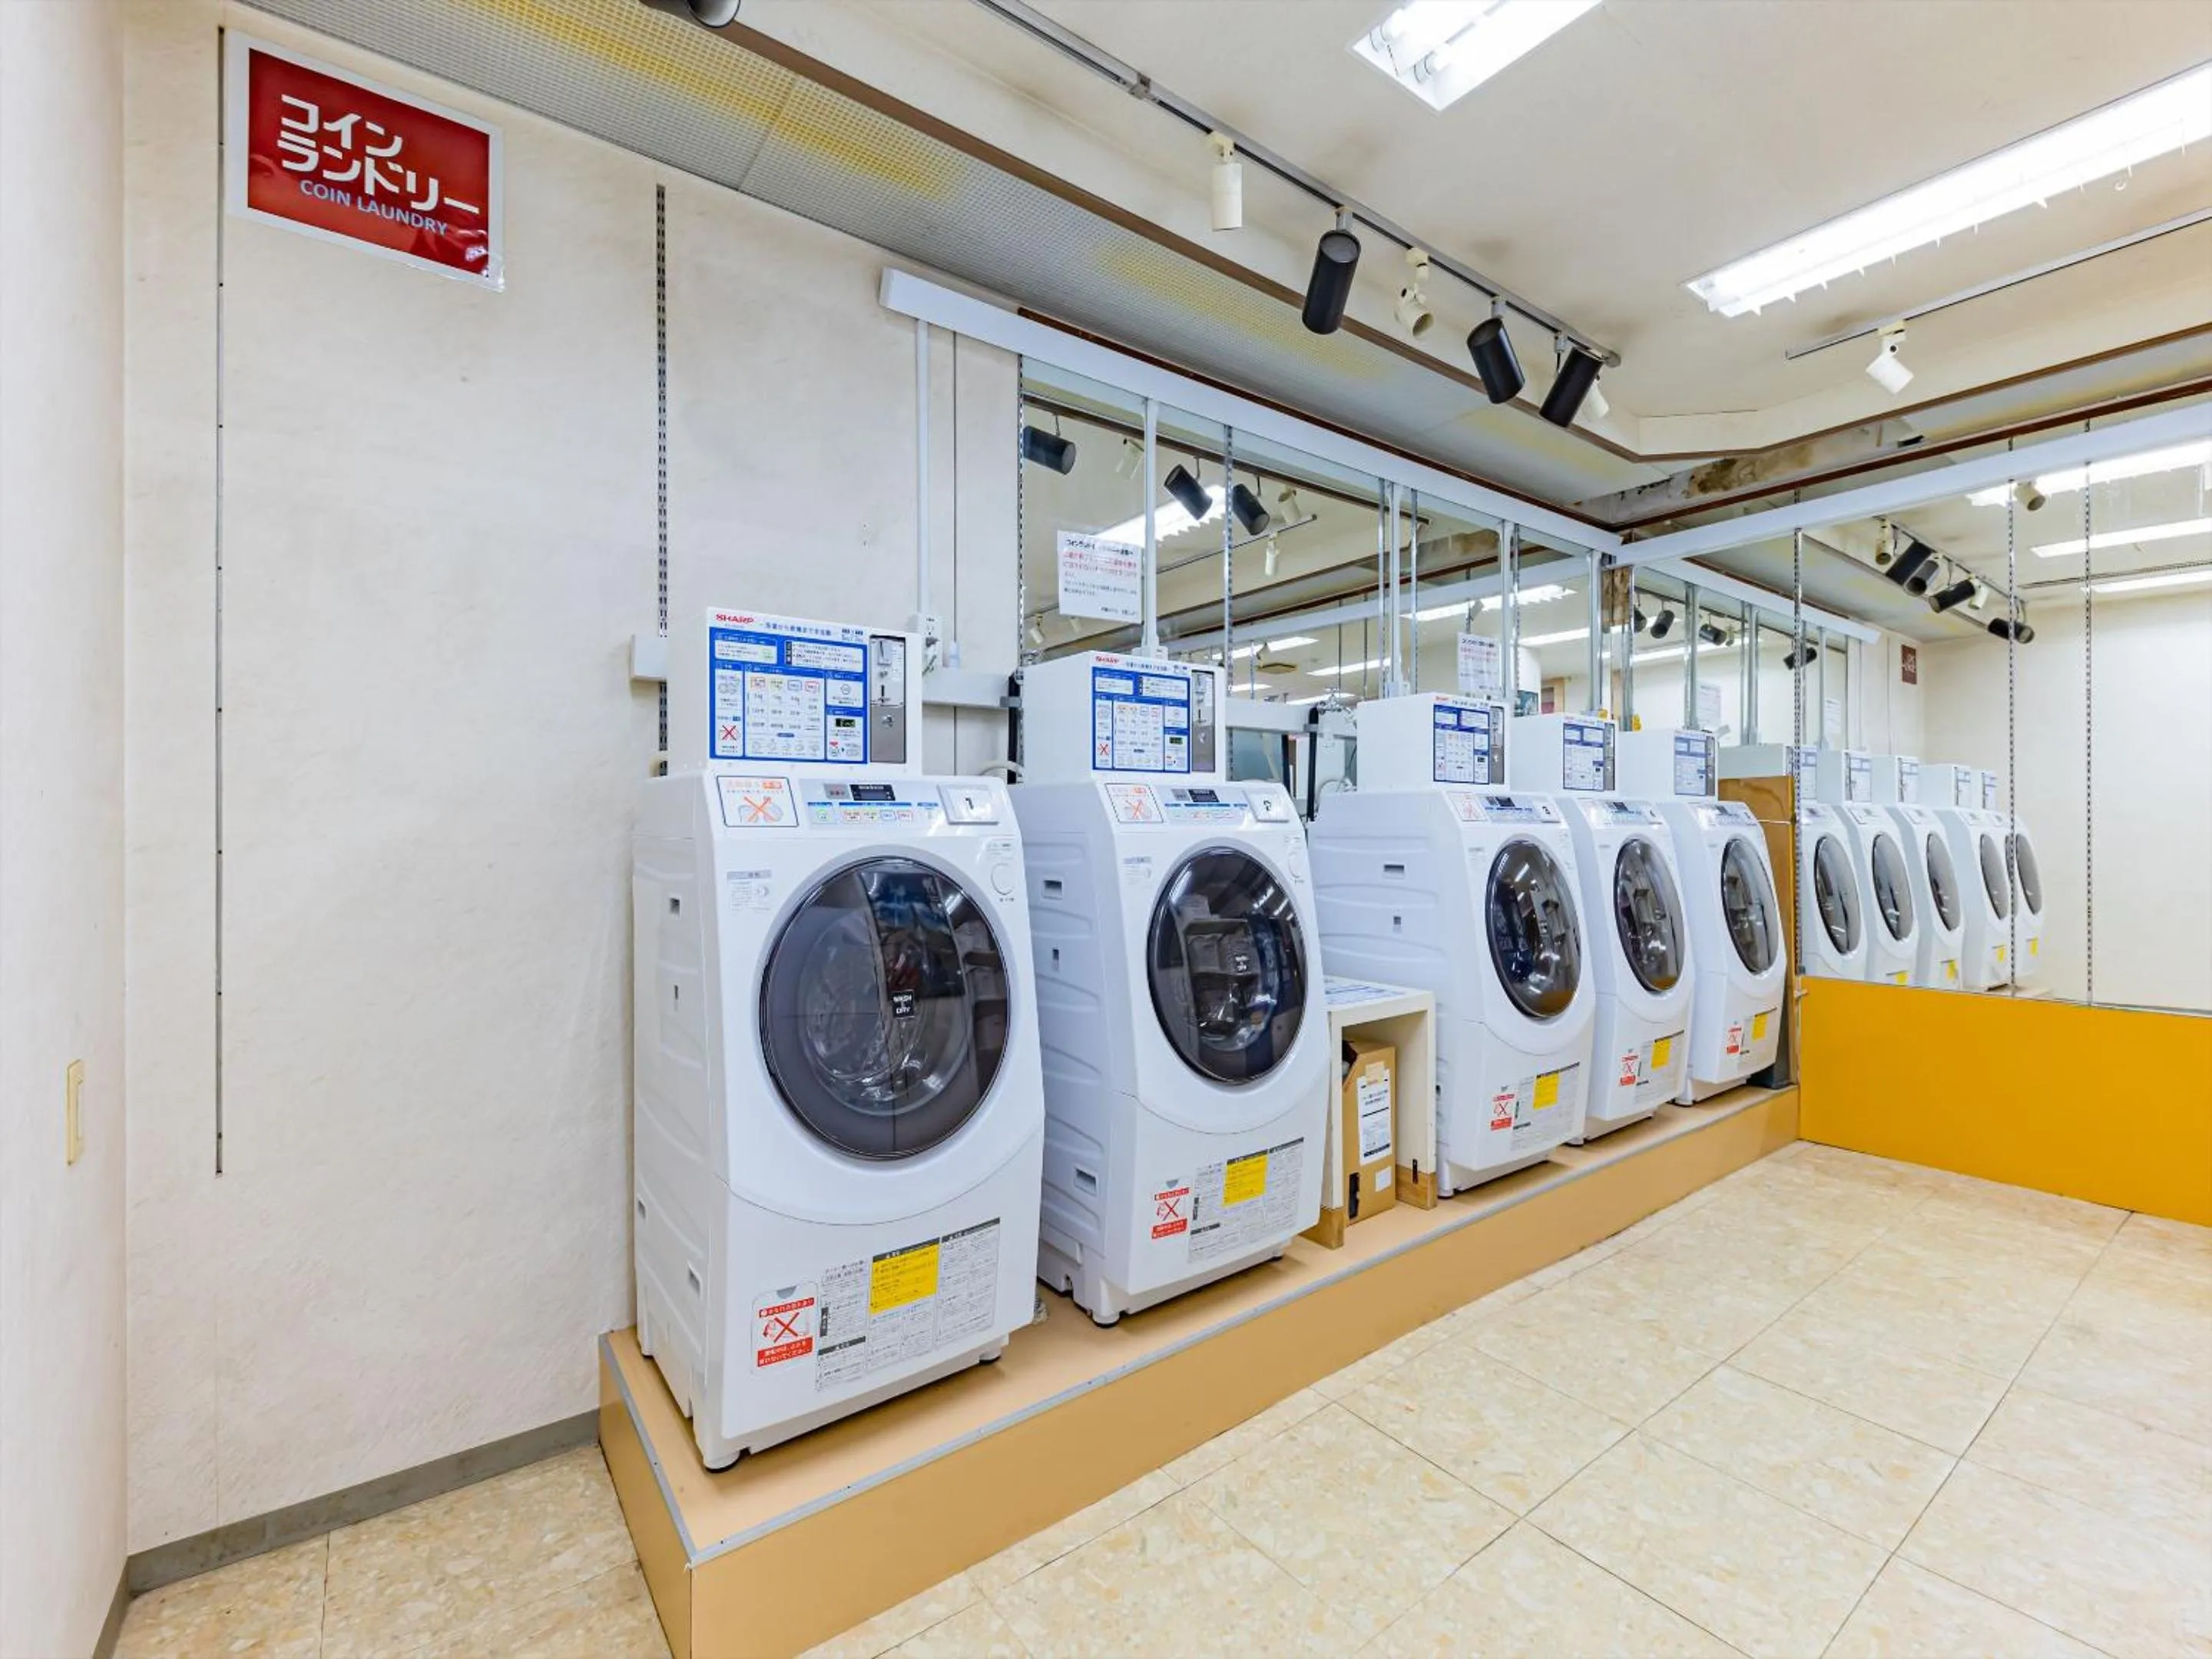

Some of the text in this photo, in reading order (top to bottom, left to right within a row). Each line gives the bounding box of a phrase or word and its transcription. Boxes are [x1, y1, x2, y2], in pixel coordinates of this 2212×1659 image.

[282, 94, 403, 157] コイン
[276, 131, 480, 215] ランドリー
[300, 180, 449, 237] COIN LAUNDRY
[715, 614, 754, 624] SHARP
